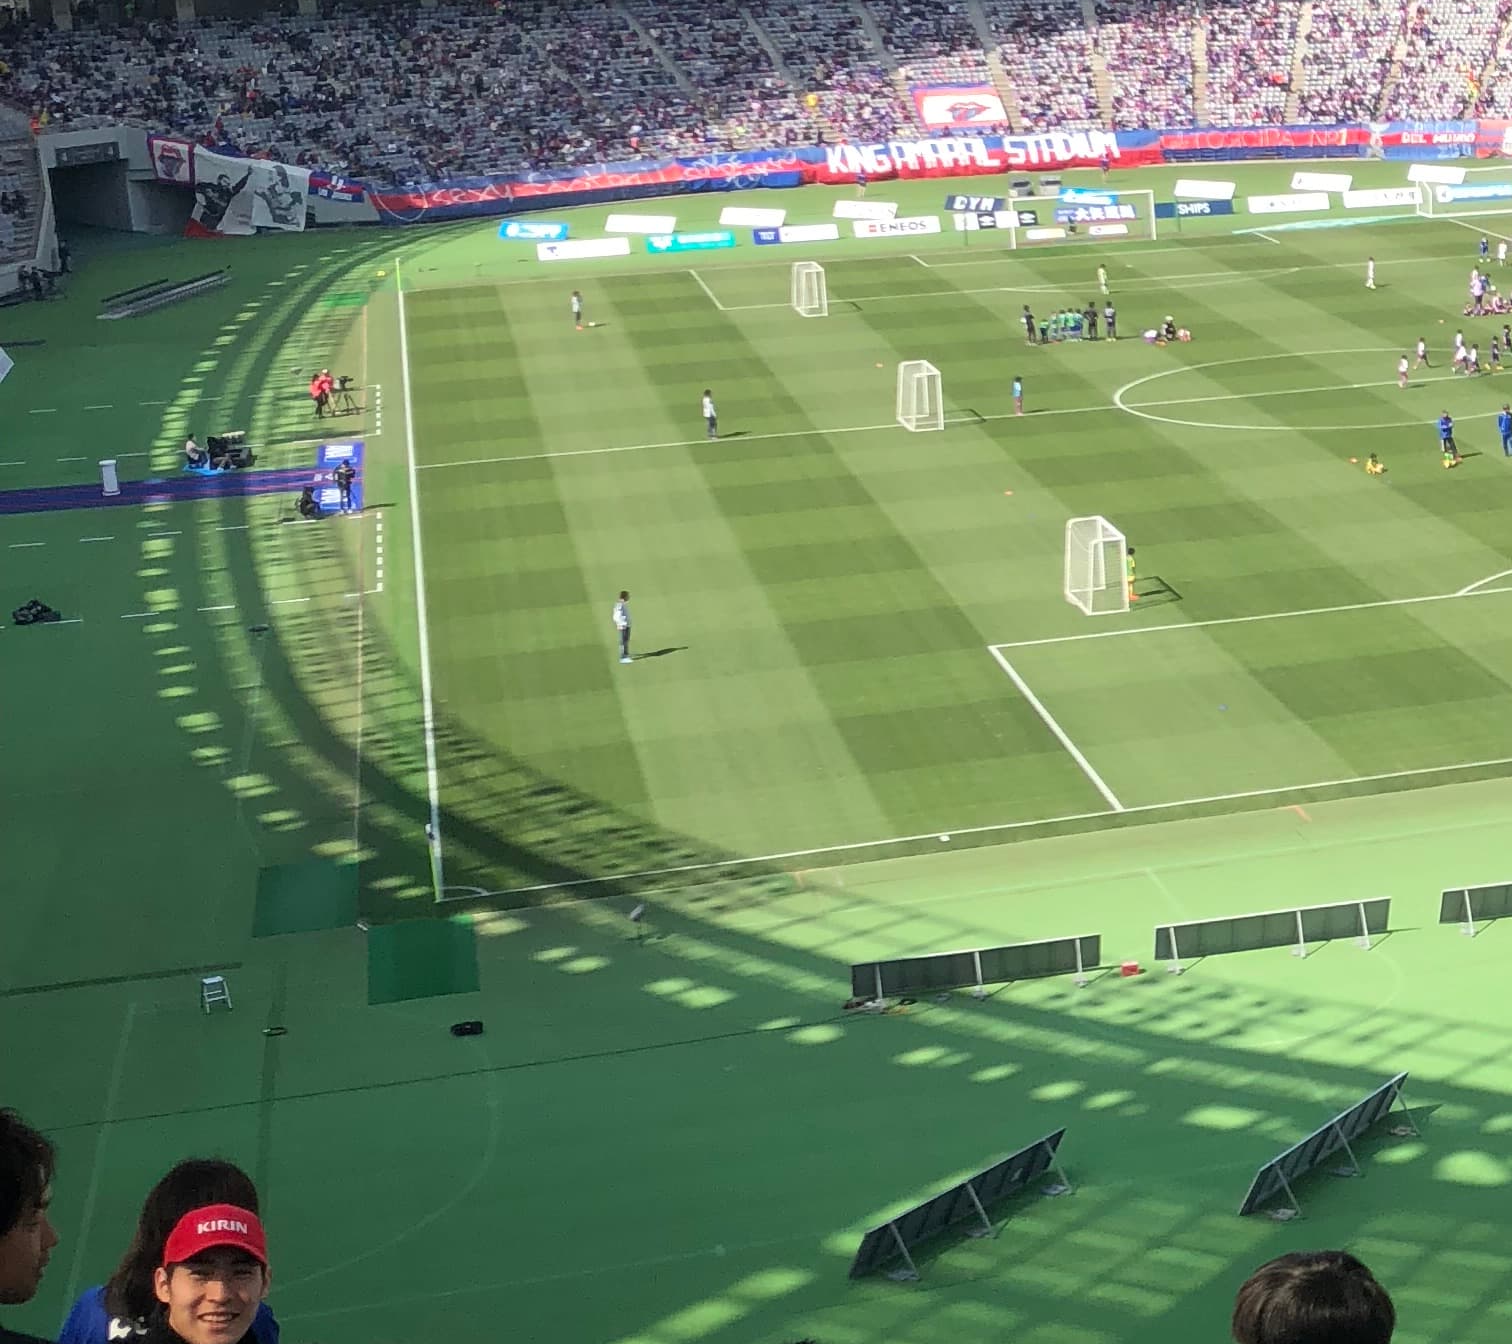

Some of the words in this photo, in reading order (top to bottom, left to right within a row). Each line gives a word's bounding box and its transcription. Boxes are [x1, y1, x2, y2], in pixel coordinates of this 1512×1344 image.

[826, 144, 893, 174] KING
[1000, 130, 1121, 164] STADIUM
[879, 220, 927, 233] ENEOS
[196, 1219, 248, 1235] KIRIN
